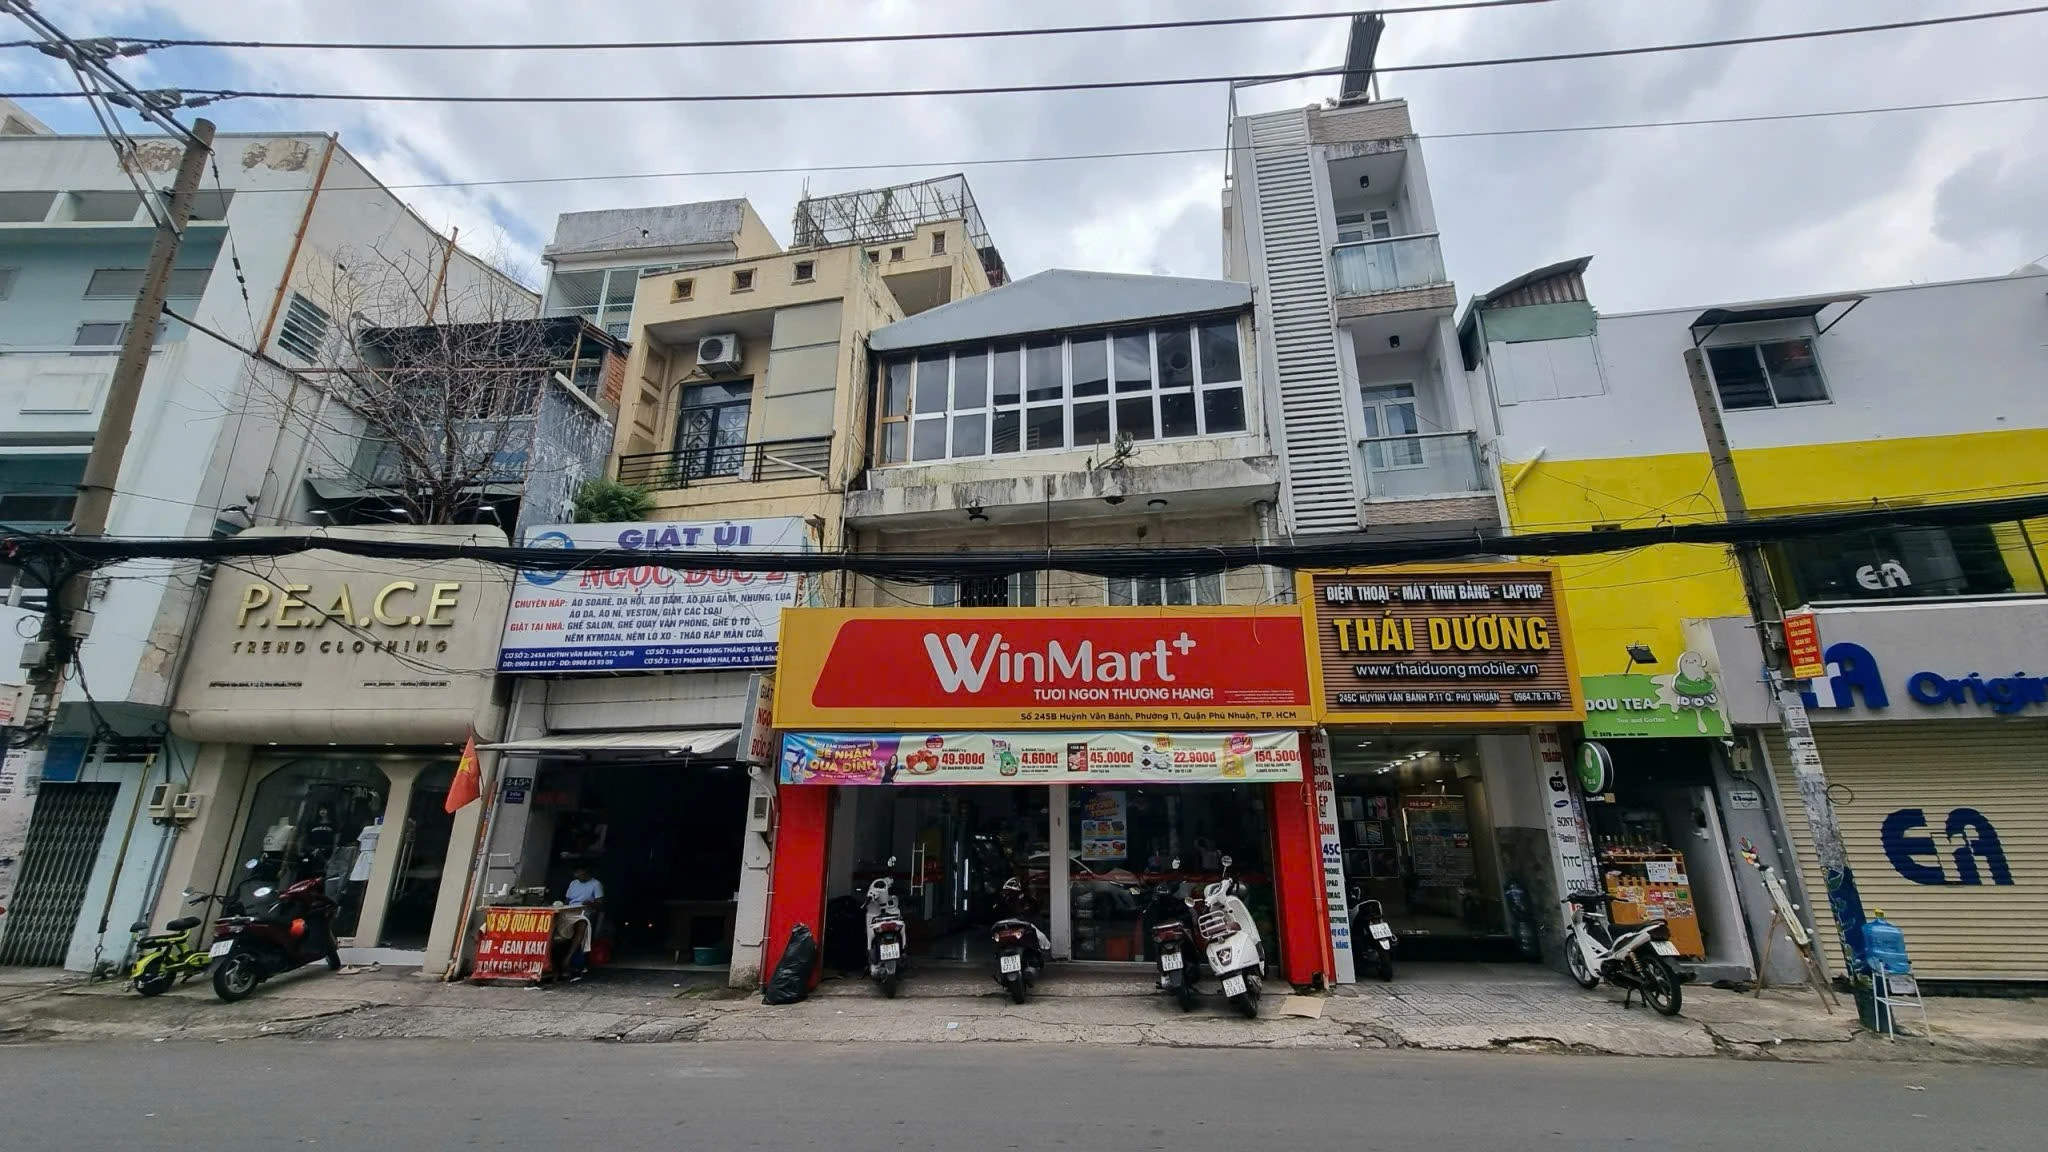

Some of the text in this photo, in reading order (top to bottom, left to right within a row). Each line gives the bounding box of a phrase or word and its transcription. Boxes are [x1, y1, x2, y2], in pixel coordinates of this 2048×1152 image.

[714, 521, 752, 546] ỦI
[1326, 580, 1544, 604] ĐIỆN THOẠI MÁY TÍNH BẢNG LAPTOP
[237, 580, 462, 629] P.E.A.C.E
[515, 599, 546, 608] CHUYÊN
[571, 597, 583, 606] ÁO
[617, 597, 629, 608] DẠ
[631, 594, 646, 606] HỘI,
[649, 595, 661, 605] ÁO
[686, 594, 699, 604] ÁO
[740, 592, 773, 603] NHUNG,
[569, 609, 581, 618] ÁO
[583, 609, 596, 618] DA,
[598, 608, 610, 618] ÁO
[626, 608, 660, 619] VESTON,
[684, 605, 703, 615] CÁC
[704, 605, 722, 616] LOẠI
[531, 622, 544, 633] TẠI
[545, 620, 565, 631] NHÀ:
[567, 619, 584, 630] GHẾ
[586, 620, 615, 630] SALON,
[617, 619, 635, 629] GHẾ
[636, 620, 657, 629] QUAY
[678, 617, 710, 628] PHÒNG,
[712, 615, 729, 626] GHẾ
[740, 615, 751, 626] TÔ
[1333, 609, 1551, 652] THÁI DƯƠNG
[565, 633, 584, 643] NỆM
[586, 632, 624, 643] KYMDAN,
[626, 632, 645, 642] NỆM
[660, 632, 671, 640] XO
[680, 630, 701, 640] THÁO
[703, 629, 721, 639] RÁP
[745, 626, 763, 638] CỬA
[232, 639, 448, 654] TREND CLOTHING
[703, 647, 723, 655] MẠNG
[723, 646, 746, 654] THÁNG
[683, 657, 702, 665] PHẠM
[703, 655, 717, 663] VĂN
[1355, 662, 1539, 678] www.thaiduongmobile.vn
[1033, 688, 1066, 700] TƯƠI
[1069, 688, 1109, 700] NGON
[1112, 687, 1169, 703] THƯỢNG
[1172, 687, 1214, 703] HẠNG!
[1339, 693, 1357, 702] 245C
[1360, 691, 1386, 702] HUỲNH
[1387, 691, 1403, 702] VĂN
[1405, 690, 1427, 702] BÁNH
[1429, 692, 1443, 702] P.11
[1445, 692, 1454, 702] Q.
[1456, 690, 1472, 701] PHÚ
[1473, 690, 1500, 703] NHUẬN
[1622, 698, 1655, 711] TEA
[1020, 710, 1297, 723] Số 245B Huỳnh Văn Bánh, Phường 11, Quận Phú Nhuận, TP. HCM
[834, 748, 872, 760] NHẬN
[942, 752, 985, 765] 49.900đ
[1021, 752, 1058, 764] 4.600đ
[1090, 751, 1134, 763] 45.000đ
[1557, 816, 1574, 827] SONY
[500, 940, 547, 955] JEAN KAKI
